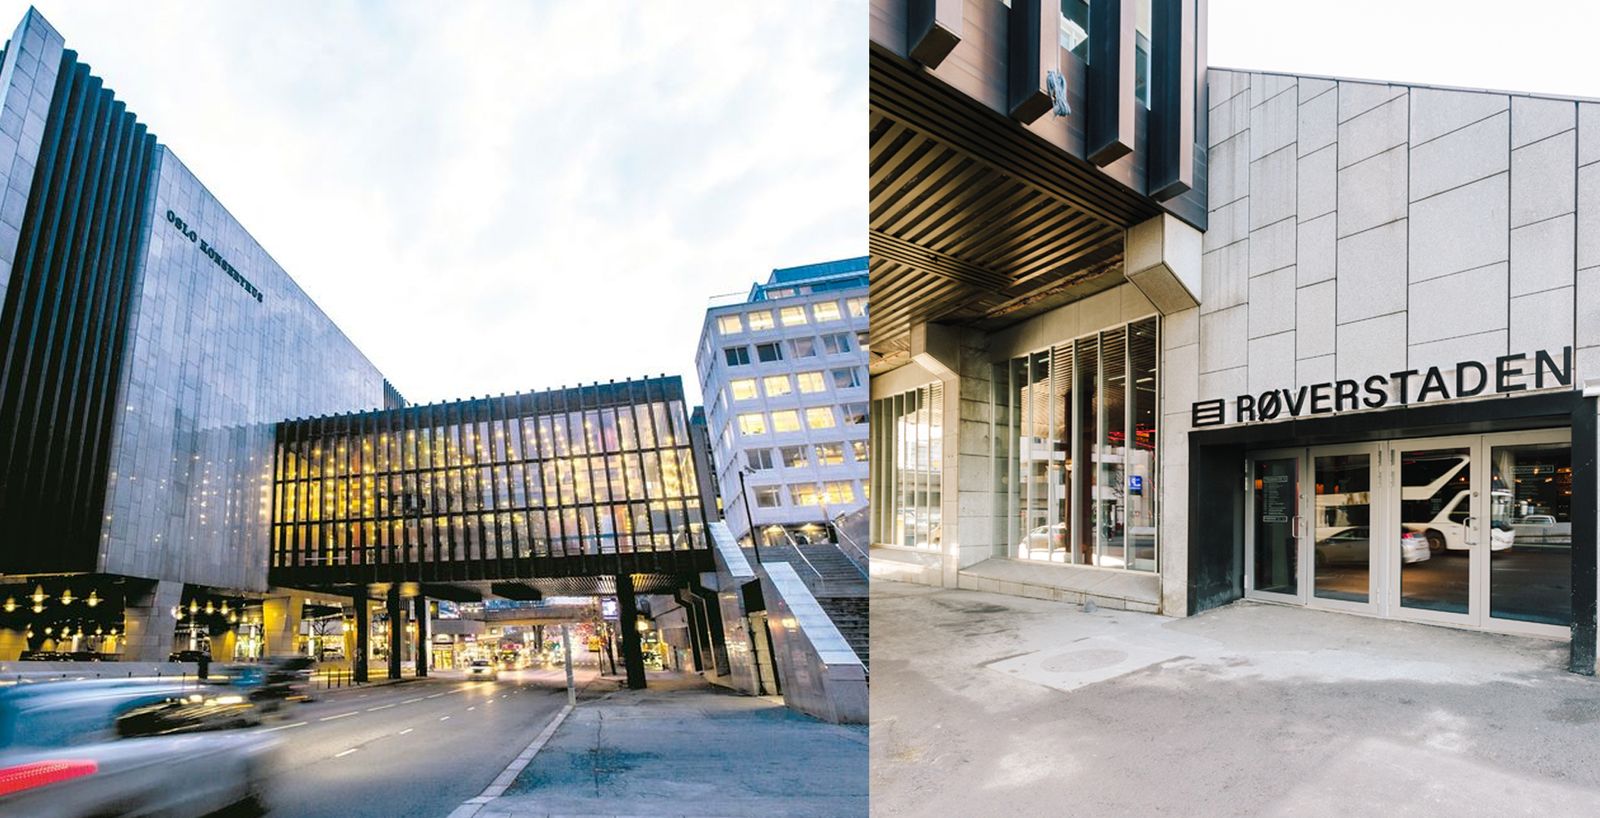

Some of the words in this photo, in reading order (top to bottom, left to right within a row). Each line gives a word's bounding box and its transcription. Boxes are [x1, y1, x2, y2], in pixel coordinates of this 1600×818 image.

[166, 209, 197, 242] OSLO
[199, 239, 263, 303] KONSERTHUS
[1236, 345, 1572, 422] RØVERSTADEN
